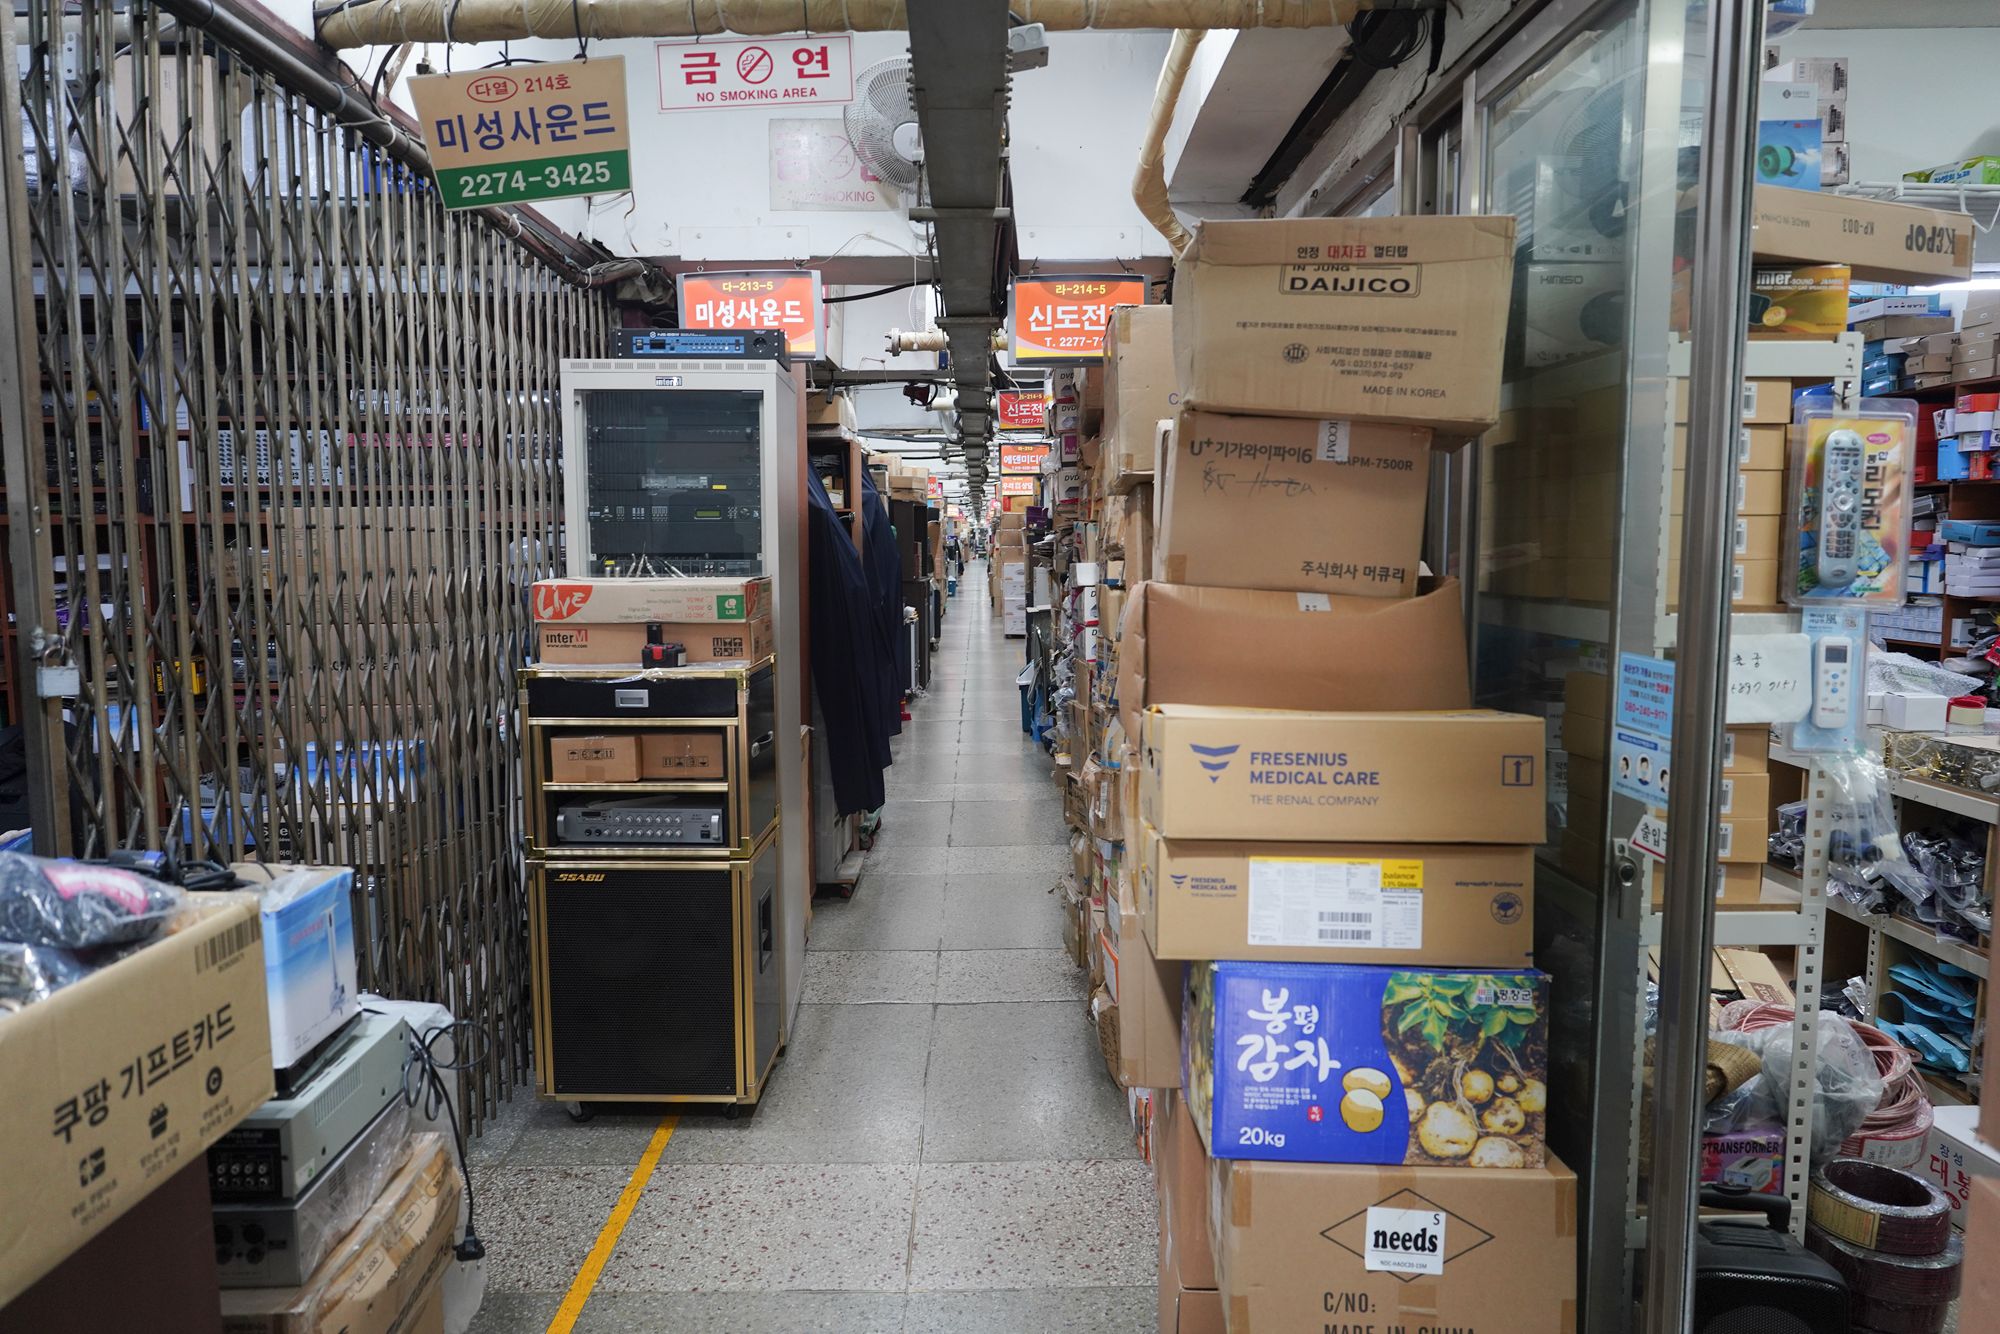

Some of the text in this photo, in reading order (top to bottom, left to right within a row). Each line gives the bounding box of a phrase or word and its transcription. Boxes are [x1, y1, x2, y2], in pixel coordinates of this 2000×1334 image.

[680, 46, 830, 85] 금 연
[475, 74, 572, 97] 다열 214호
[696, 87, 818, 102] NO SMOKING AREA
[435, 101, 616, 153] 미성사운드
[459, 161, 611, 198] 2274-3425
[1843, 218, 1875, 236] KP-003
[1297, 245, 1408, 259] 인정 대지코 멀티탭
[722, 281, 774, 292] 다-213-5
[1055, 284, 1106, 295] 라-214-5
[1290, 277, 1410, 293] DAIJICO
[695, 298, 805, 329] 미성사운드
[1028, 304, 1108, 332] 신도전
[1044, 337, 1056, 347] T.
[1362, 385, 1447, 398] MADE IN KOREA
[1007, 403, 1044, 416] 신도전
[1301, 561, 1406, 583] 주식회사 머큐리
[1249, 752, 1348, 767] FRESENIUS
[1249, 771, 1380, 786] MEDICAL CARE
[1250, 795, 1379, 806] THE RENAL COMPANY
[1499, 989, 1531, 1001] 평창군
[1247, 988, 1320, 1032] 봉평
[1236, 1034, 1342, 1082] 감자
[53, 1077, 112, 1144] 쿠팡
[119, 1003, 236, 1101] 기프트카드
[1239, 1127, 1286, 1147] 20kg
[1433, 1213, 1440, 1225] S
[1373, 1228, 1438, 1253] needs
[1324, 1292, 1376, 1314] C/NO:
